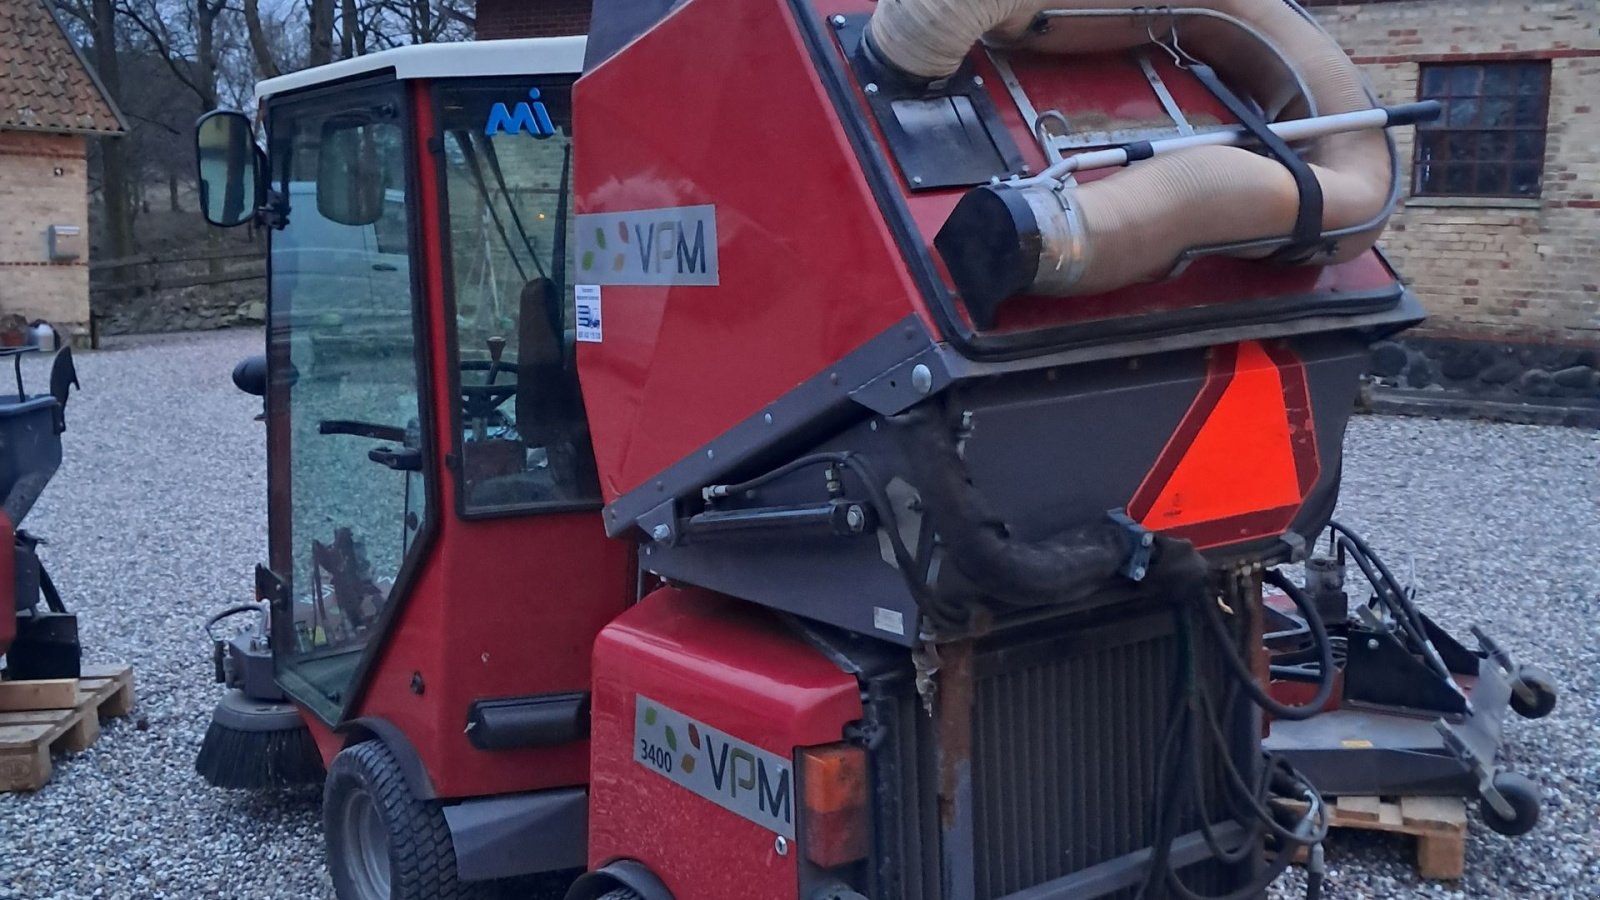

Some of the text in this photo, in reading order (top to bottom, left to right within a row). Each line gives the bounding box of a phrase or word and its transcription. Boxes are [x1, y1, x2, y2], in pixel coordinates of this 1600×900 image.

[635, 220, 707, 274] VPM
[640, 738, 672, 773] 3400
[705, 734, 791, 824] VPM
